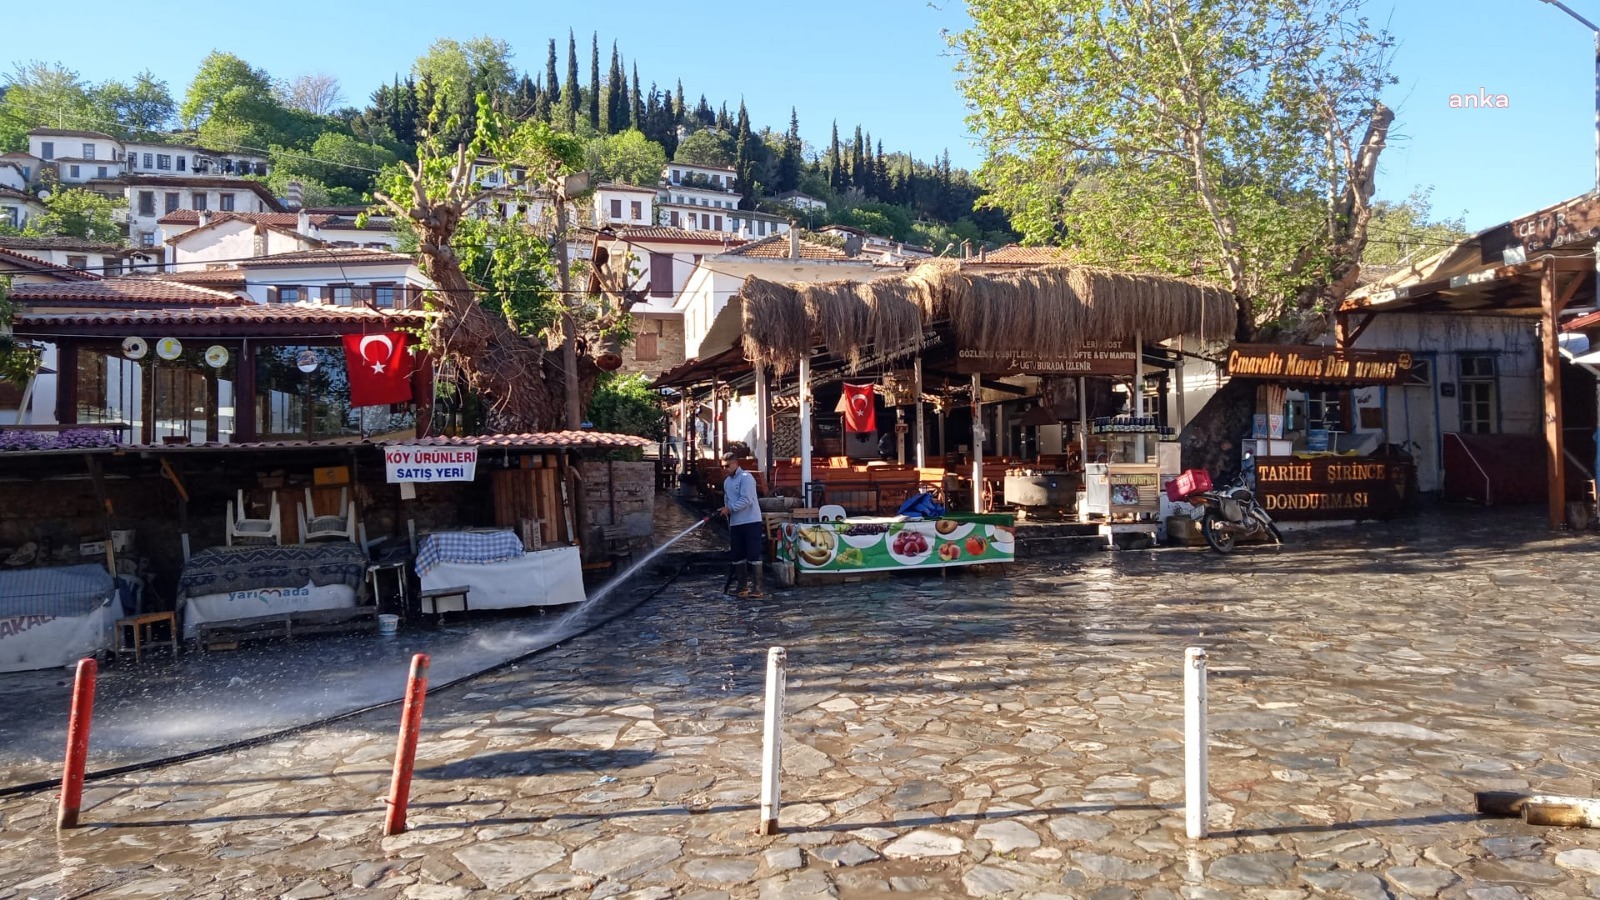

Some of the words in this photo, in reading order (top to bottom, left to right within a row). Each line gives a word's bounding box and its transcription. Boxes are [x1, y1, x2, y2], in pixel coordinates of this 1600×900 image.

[1070, 349, 1092, 359] ÖFTE
[1099, 351, 1109, 360] EV
[1037, 361, 1064, 370] BURADA
[1066, 360, 1092, 371] İZLENİR
[386, 449, 411, 464] KÖY
[414, 449, 476, 464] ÜRÜNLERİ
[396, 468, 432, 481] SATIŞ
[435, 465, 464, 478] YERİ
[1258, 462, 1312, 481] TARİHİ
[1327, 462, 1386, 484] ŞİRİNCE
[1265, 493, 1369, 510] DONDURMASI
